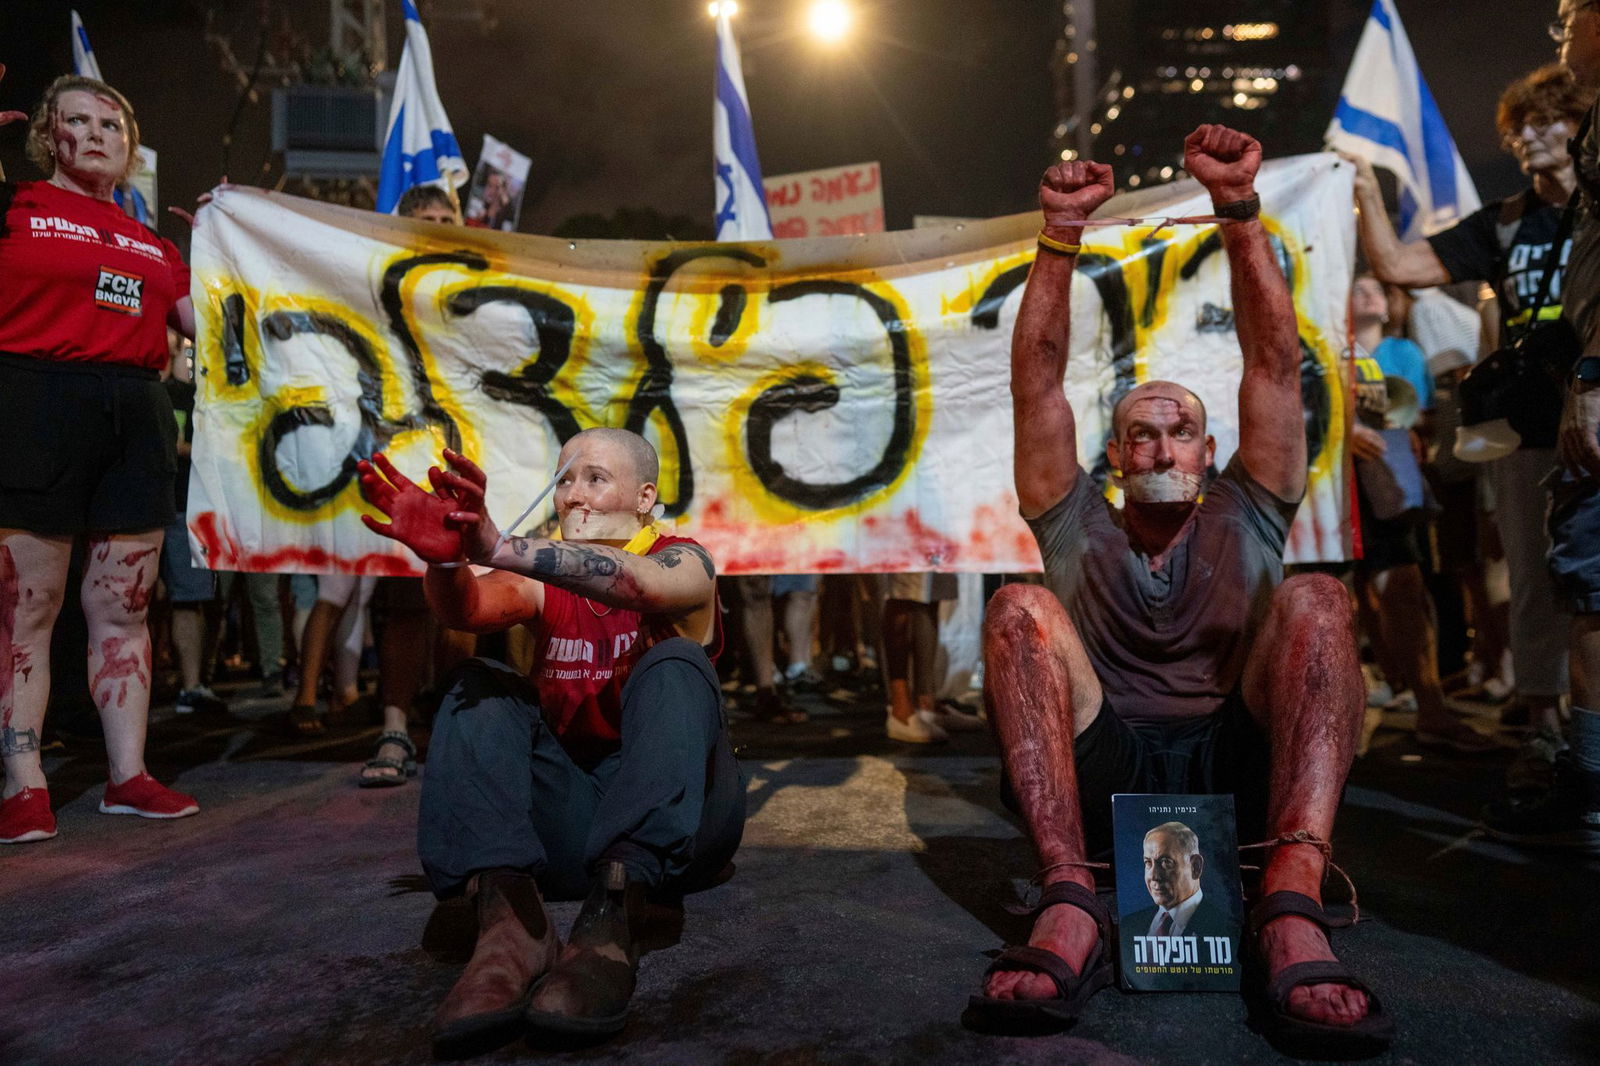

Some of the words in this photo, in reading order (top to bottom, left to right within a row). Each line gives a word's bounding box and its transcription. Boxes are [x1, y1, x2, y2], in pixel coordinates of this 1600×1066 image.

[98, 271, 142, 298] FCK
[95, 289, 141, 309] BNGVR
[1174, 806, 1197, 814] בנימין
[1133, 935, 1199, 966] הפקרה
[1203, 936, 1232, 964] מר
[1190, 965, 1201, 974] של
[1205, 966, 1233, 975] מורשתו
